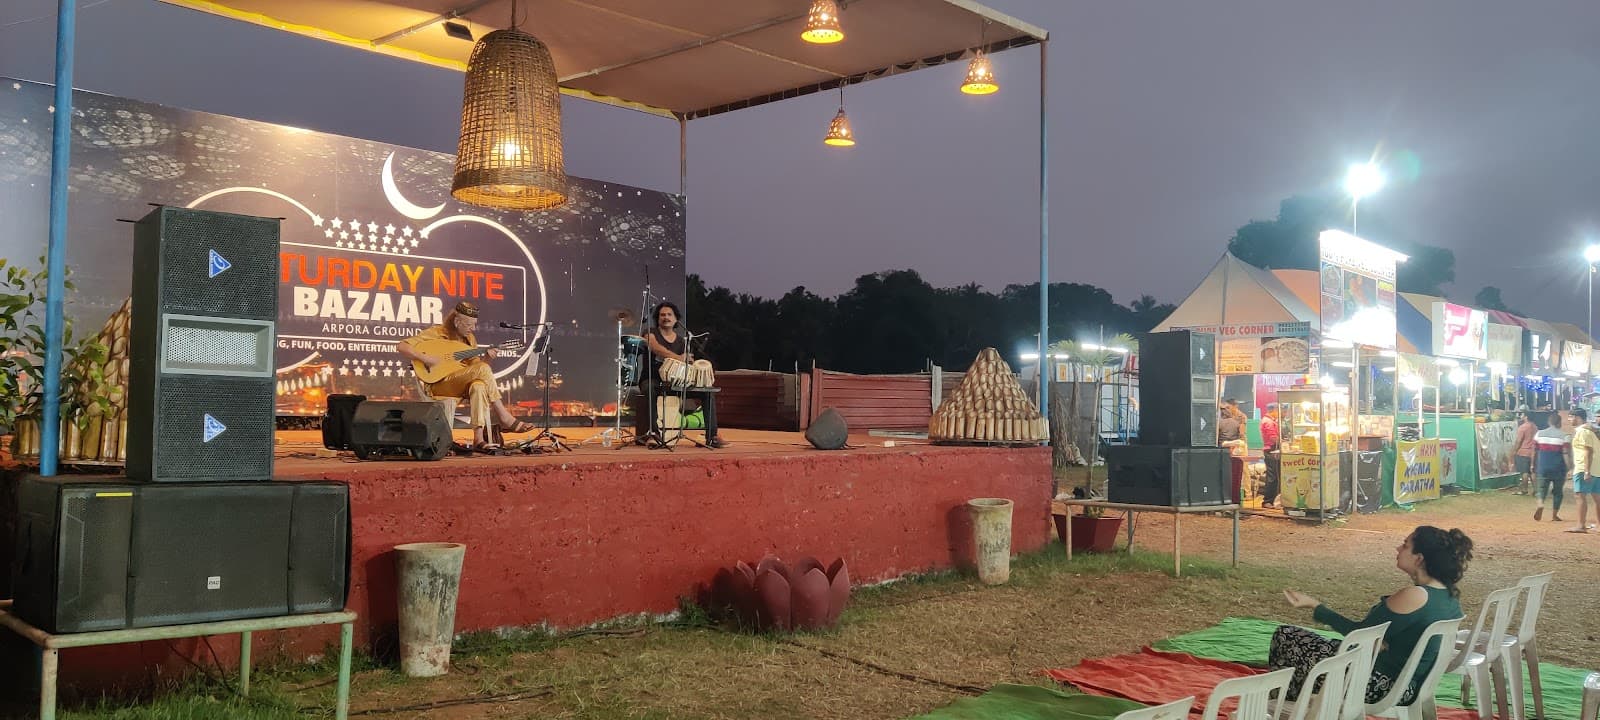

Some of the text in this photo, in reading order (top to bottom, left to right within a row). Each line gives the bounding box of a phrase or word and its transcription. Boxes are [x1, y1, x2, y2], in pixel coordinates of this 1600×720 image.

[433, 267, 504, 301] NITE
[293, 286, 443, 325] BAZAAR
[322, 323, 370, 335] ARPORA
[1219, 325, 1236, 336] VEG
[1238, 324, 1275, 336] CORNER
[276, 339, 289, 349] G,
[291, 340, 315, 350] FUN,
[316, 341, 346, 351] FOOD,
[348, 343, 400, 353] ENTERTAIN
